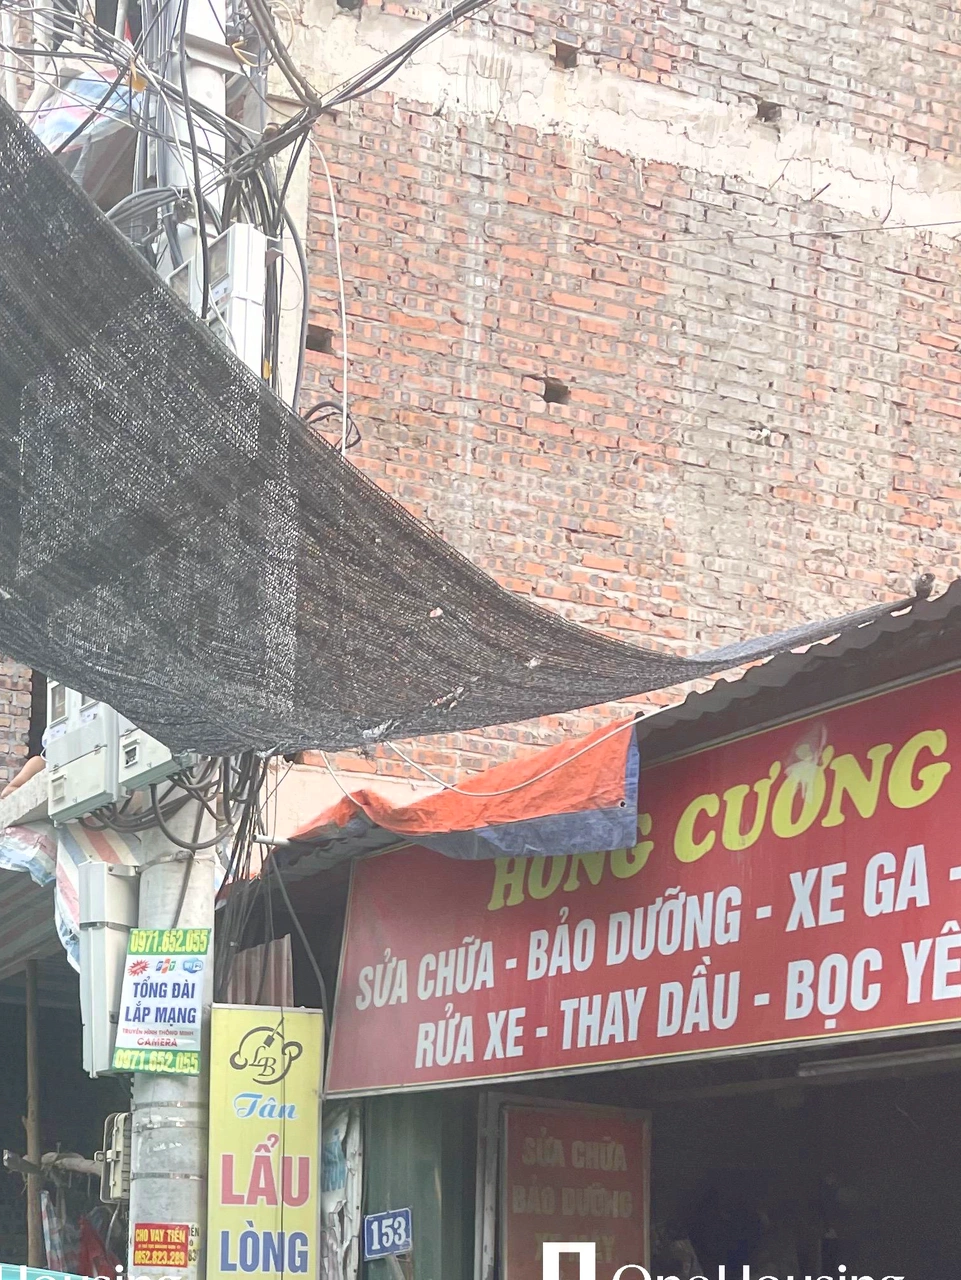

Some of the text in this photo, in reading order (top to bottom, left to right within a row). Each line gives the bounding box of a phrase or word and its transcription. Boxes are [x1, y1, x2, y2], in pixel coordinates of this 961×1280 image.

[355, 948, 408, 1011] SỬA
[417, 935, 495, 1001] CHỮA
[527, 906, 596, 981] BẢO
[606, 885, 742, 966] DƯỠNG
[785, 861, 847, 932] XE
[863, 844, 930, 917] GA
[130, 930, 208, 953] 0971.652.055
[133, 976, 196, 998] TỔNG ĐÀI
[125, 1001, 197, 1027] LẮP MẠNG
[415, 1003, 475, 1068] RỬA
[483, 1007, 526, 1060] XE
[560, 987, 647, 1050] THAY
[657, 955, 741, 1038] DẦU
[784, 948, 883, 1029] BỌC
[137, 1037, 178, 1047] CAMERA
[233, 1092, 298, 1119] Tân
[221, 1133, 310, 1207] LẨU
[150, 1229, 165, 1242] VAY
[371, 1216, 406, 1250] 153
[219, 1220, 309, 1274] LÒNG
